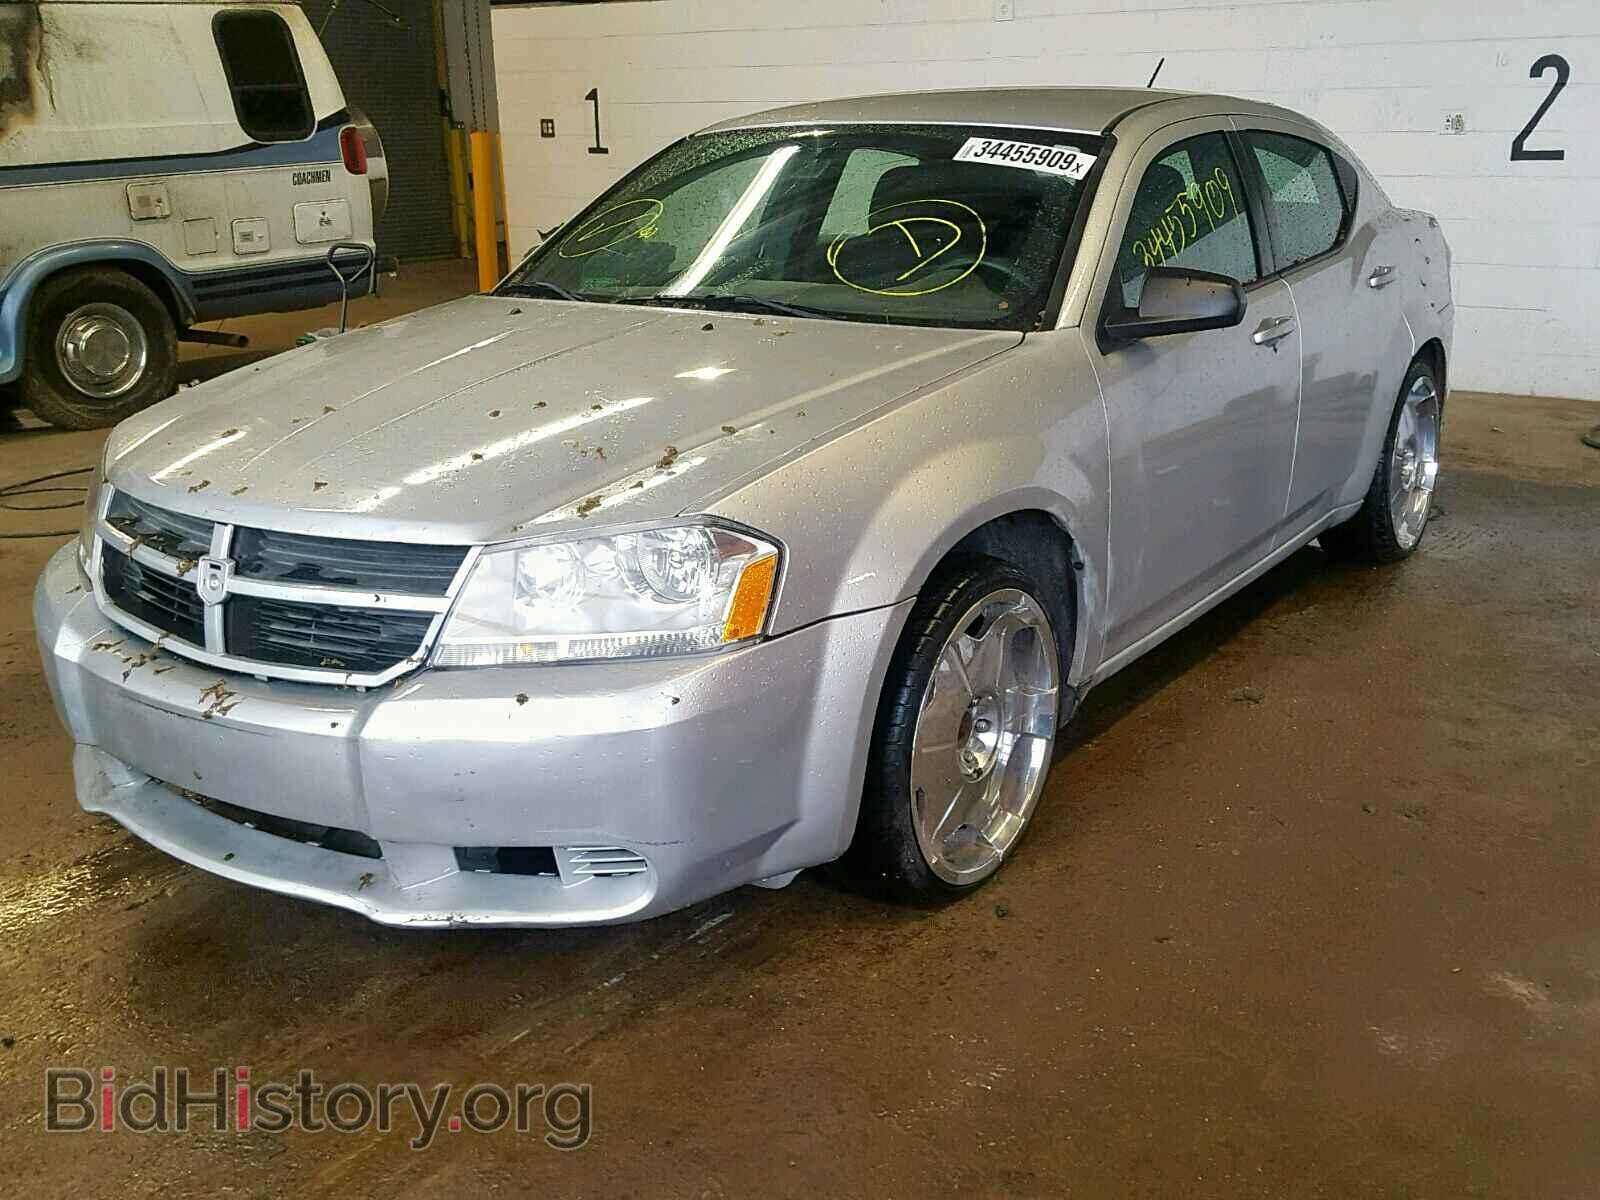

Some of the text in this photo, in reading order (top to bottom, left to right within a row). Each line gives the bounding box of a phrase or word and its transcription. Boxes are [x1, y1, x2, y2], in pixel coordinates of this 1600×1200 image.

[584, 87, 609, 154] 1
[1510, 54, 1570, 161] 2
[292, 169, 331, 186] COACHMEN
[973, 140, 1077, 170] 34455909
